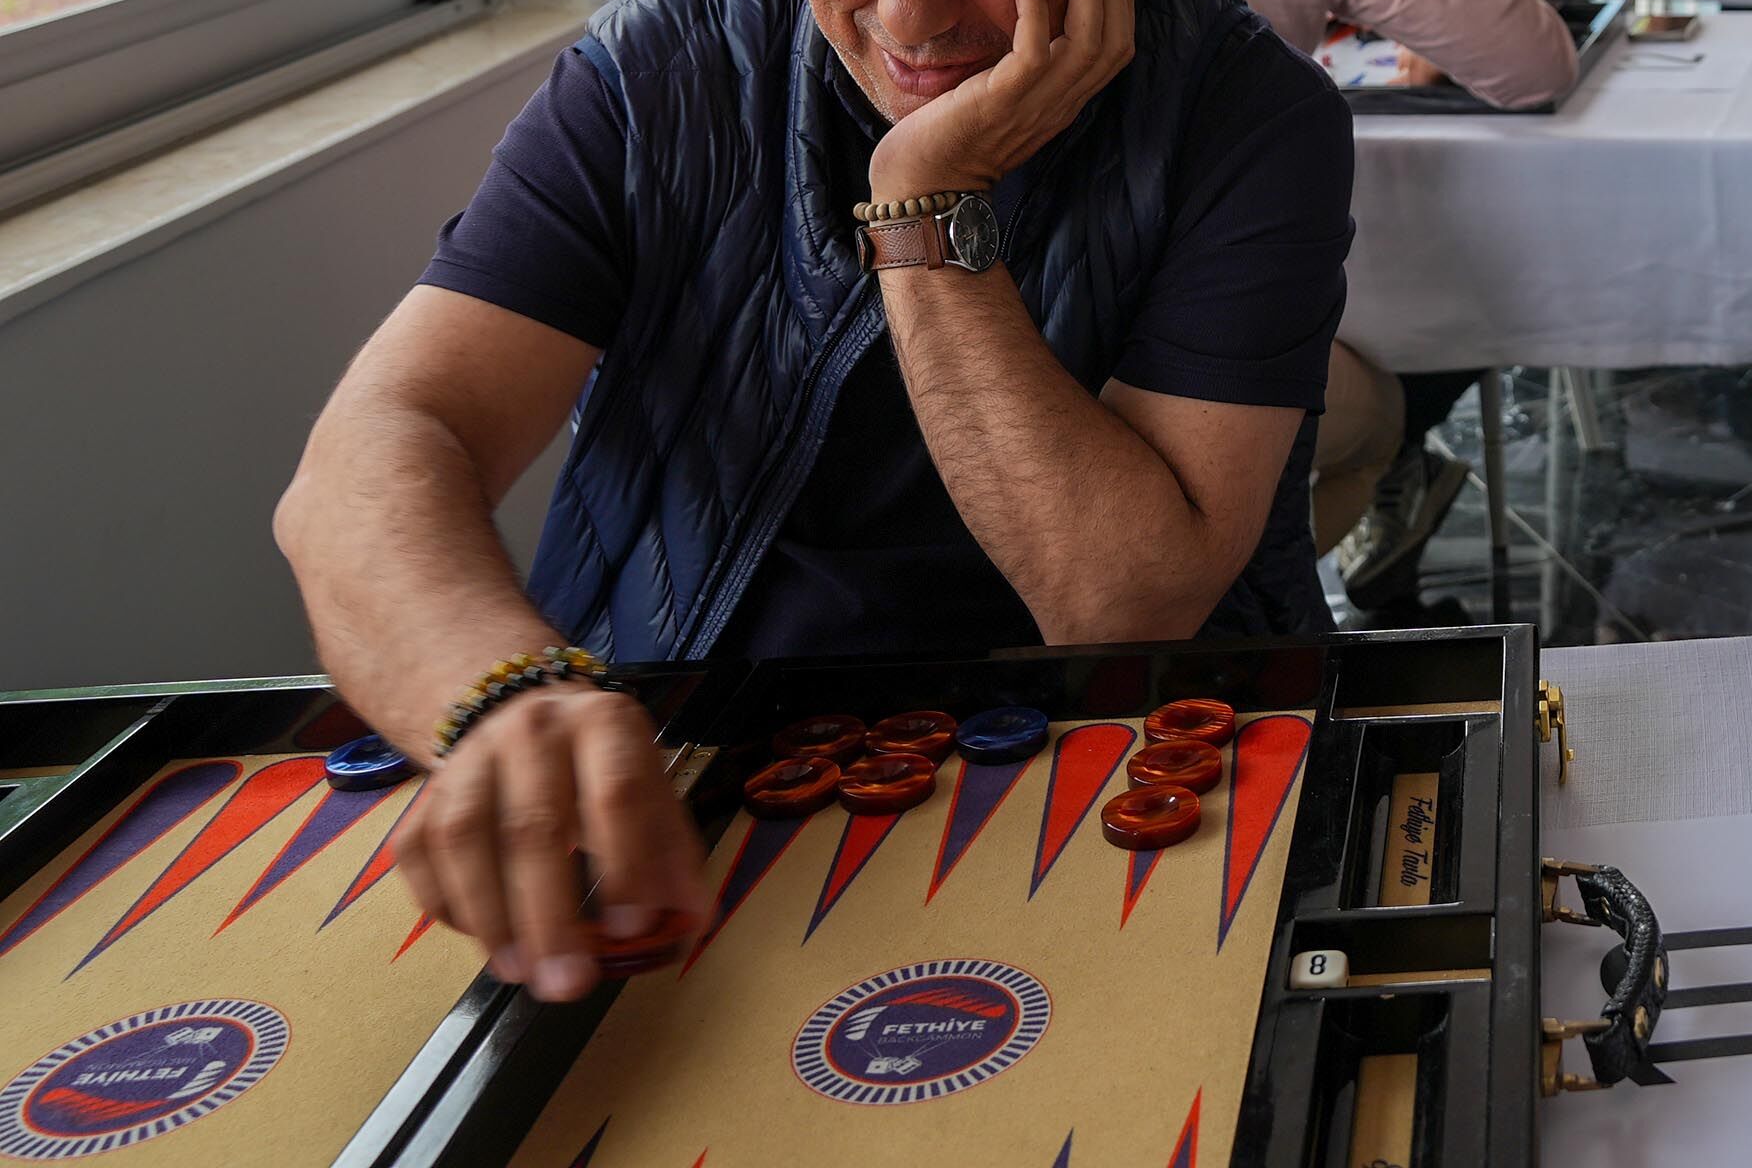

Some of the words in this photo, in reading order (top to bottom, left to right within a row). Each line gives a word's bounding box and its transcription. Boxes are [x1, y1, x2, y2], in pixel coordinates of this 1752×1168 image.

[1400, 796, 1435, 844] Fethiye
[1400, 849, 1428, 887] Tavla
[1309, 954, 1327, 975] 8
[881, 1017, 988, 1036] FETHİYE
